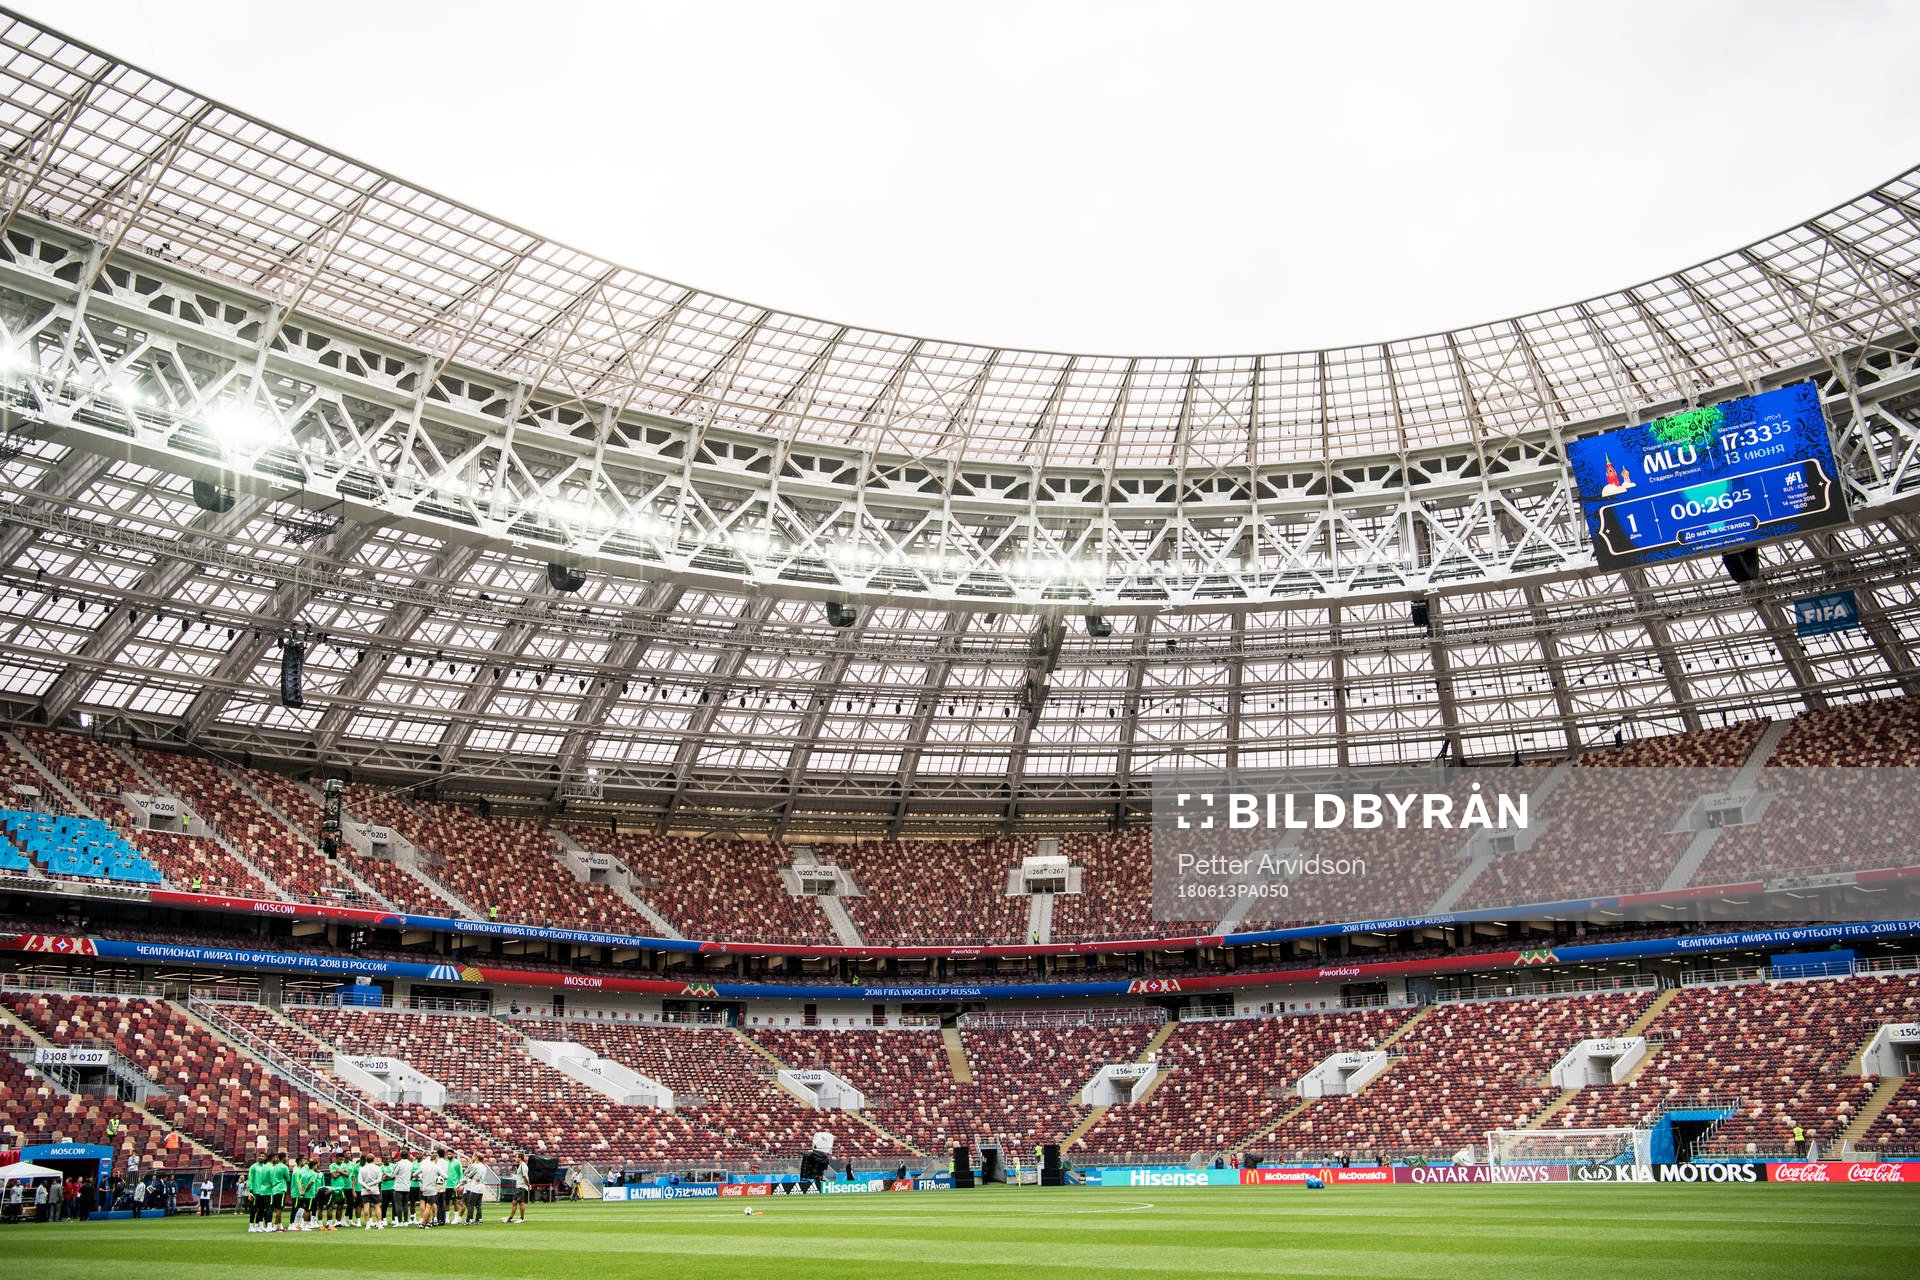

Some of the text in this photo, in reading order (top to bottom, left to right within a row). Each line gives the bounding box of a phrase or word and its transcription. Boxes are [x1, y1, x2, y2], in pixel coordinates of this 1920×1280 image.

[1720, 420, 1791, 451] 17:33 35
[1643, 444, 1697, 475] MLU
[1725, 451, 1741, 465] 13
[1785, 470, 1803, 486] #1
[1671, 488, 1752, 520] 00:26 25
[1626, 513, 1638, 533] 1
[1685, 520, 1751, 540] До матча осталось
[1804, 604, 1848, 624] FIFA
[160, 803, 175, 811] 206
[254, 902, 296, 914] MOSCOW
[1342, 914, 1456, 933] 2018 FIFA WORLD CUP RUSSIA
[454, 921, 502, 933] ЧЕМПИОНАТ
[502, 926, 526, 936] МИРА
[526, 928, 538, 937] ПО
[573, 932, 589, 942] FIFA
[589, 934, 605, 943] 2018
[605, 936, 612, 944] В
[612, 937, 641, 947] РОССИИ
[1677, 935, 1740, 948] ЧЕМПИОНАТ
[1742, 932, 1773, 944] МИРА
[1774, 931, 1790, 940] ПО
[1792, 926, 1843, 939] ФУТБОЛУ
[1845, 925, 1870, 935] FIFA
[1871, 923, 1897, 933] 2018
[1899, 922, 1907, 931] В
[136, 945, 388, 971] ЧЕМПИОНАТ МИРА ПО ФУТБОЛУ FIFA 2018 В РОССИИ
[1319, 967, 1360, 978] #worldcup
[564, 976, 603, 988] MOSCOW
[864, 988, 883, 996] 2018
[883, 988, 901, 996] FIFA
[901, 988, 932, 996] WORLD
[932, 988, 950, 996] CUP
[1900, 1028, 1918, 1037] 150
[86, 1053, 103, 1062] 107
[375, 1061, 388, 1069] 105
[50, 1147, 86, 1156] MOSCOW
[1130, 1170, 1209, 1186] Hisense
[1338, 1171, 1387, 1180] McDonald's
[1411, 1166, 1550, 1183] QATAR AIRWAYS
[1616, 1163, 1757, 1182] KIA MOTORS
[1775, 1163, 1828, 1182] Coca-Cola
[1847, 1163, 1903, 1182] Coca-Cola
[630, 1187, 662, 1199] GAZPROM
[822, 1182, 867, 1194] Hisense
